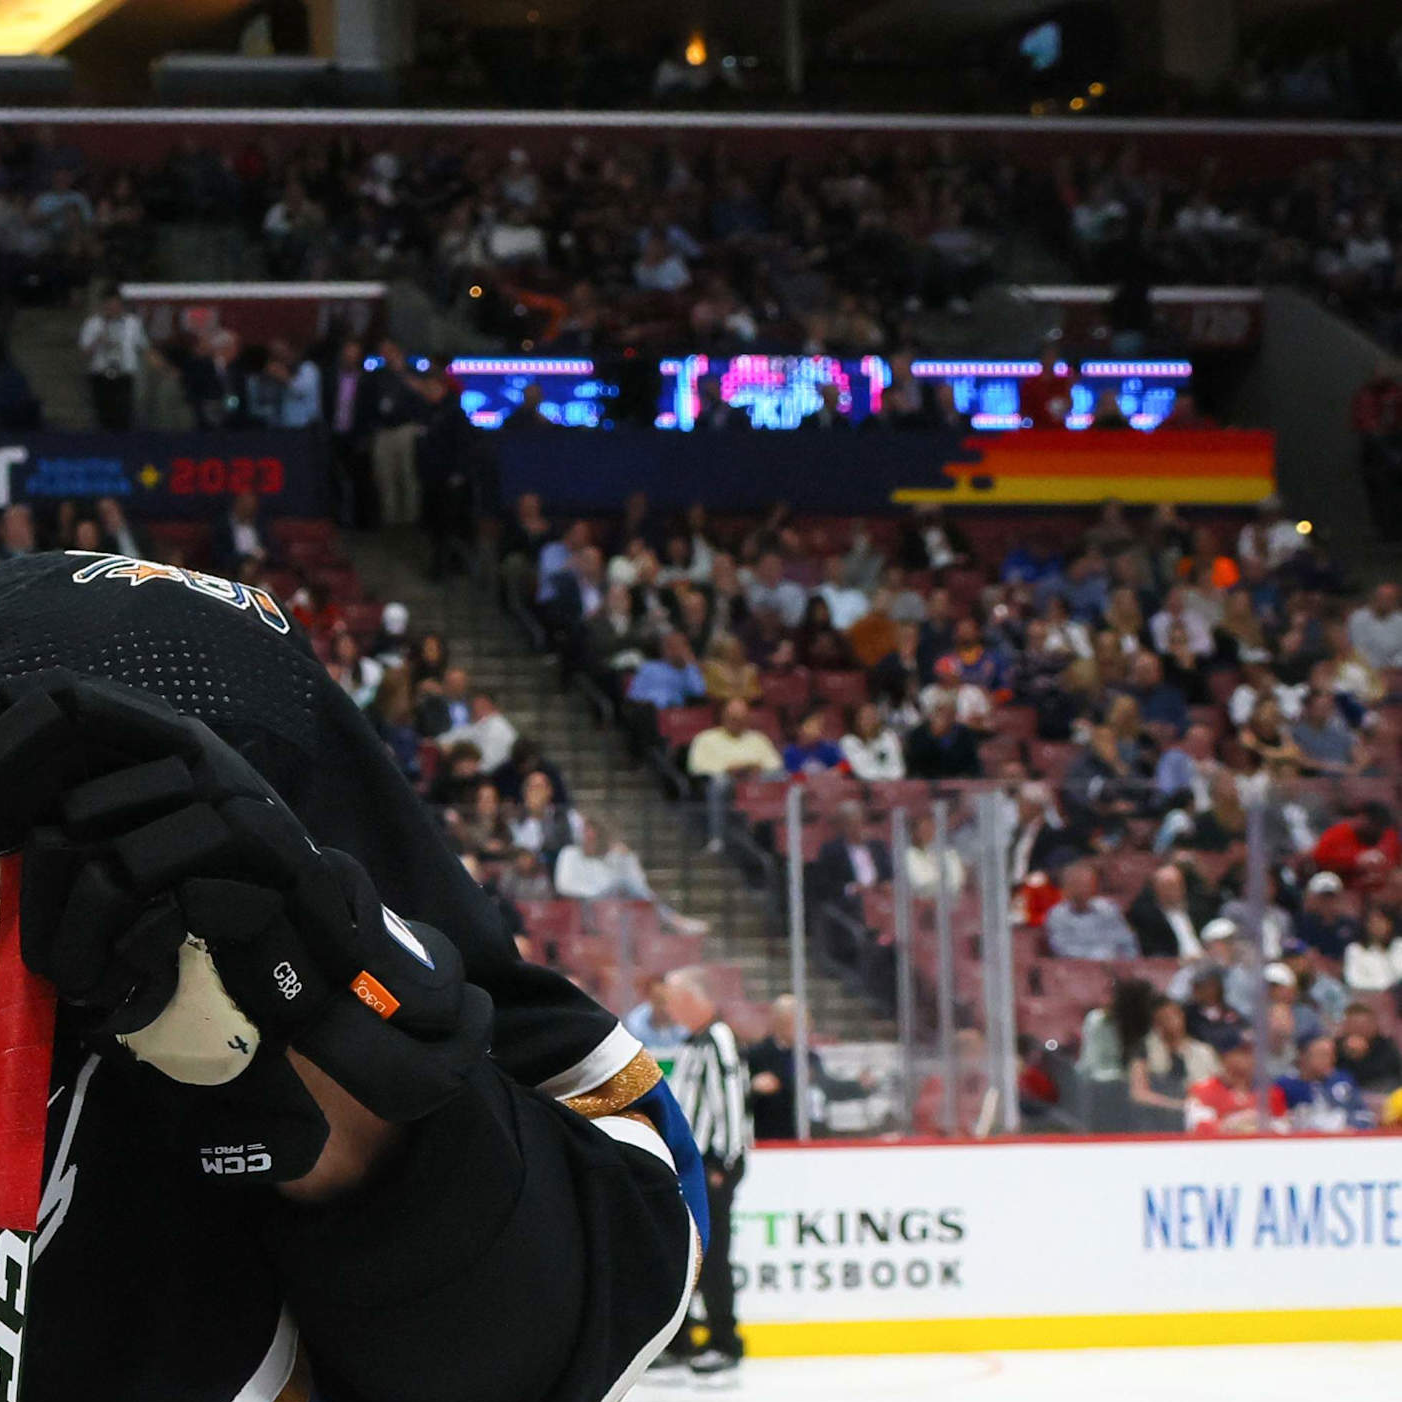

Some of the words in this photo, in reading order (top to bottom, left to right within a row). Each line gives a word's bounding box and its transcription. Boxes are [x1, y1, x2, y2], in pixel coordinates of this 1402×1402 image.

[170, 456, 285, 495] 2023
[273, 960, 303, 1001] GR8
[200, 1152, 273, 1176] CCM
[213, 1143, 244, 1155] PRO
[1142, 1185, 1241, 1250] NEW
[1253, 1181, 1402, 1248] AMSTE
[732, 1259, 964, 1293] ORTSBOOK
